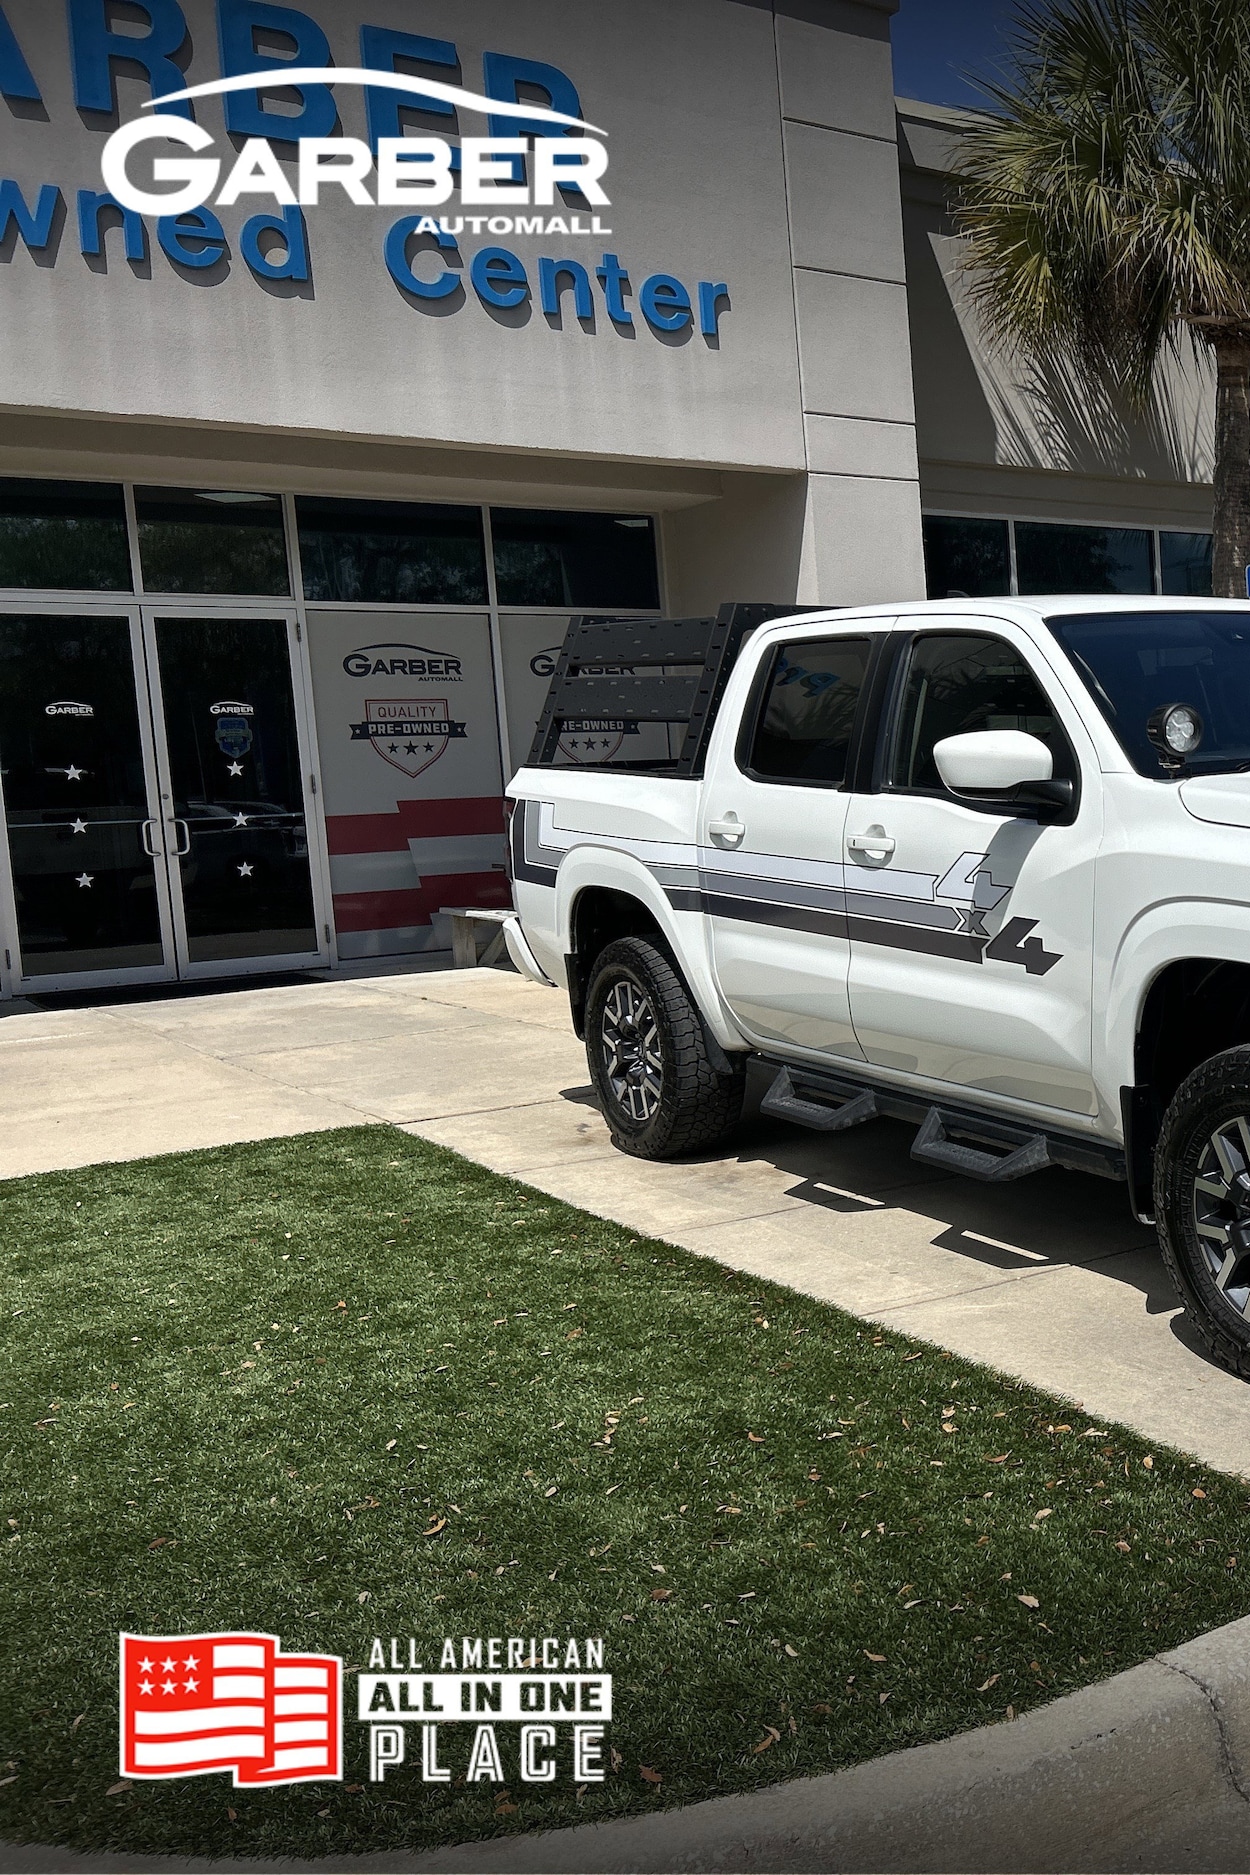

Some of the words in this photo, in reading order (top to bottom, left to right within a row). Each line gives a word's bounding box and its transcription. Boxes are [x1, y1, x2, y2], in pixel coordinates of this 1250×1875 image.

[384, 215, 729, 337] Center
[343, 653, 462, 677] GARBER
[45, 705, 94, 715] GARBER
[378, 706, 436, 718] QUALITY
[368, 723, 450, 735] PRE-OWNED
